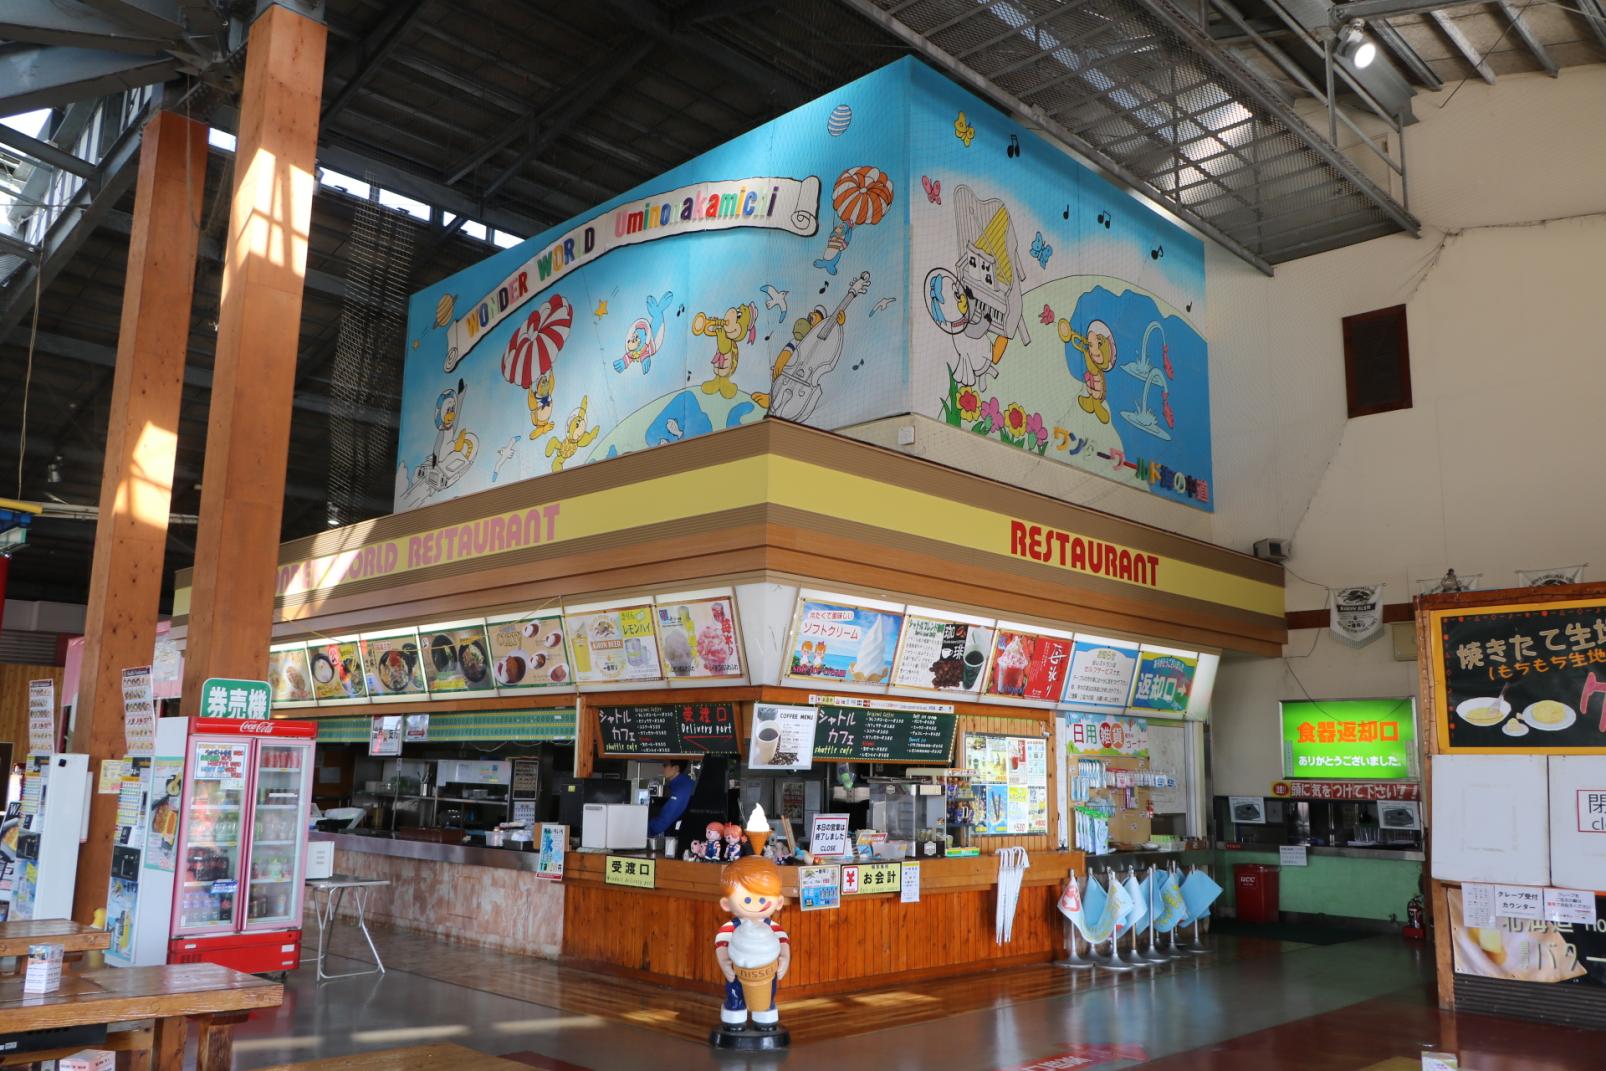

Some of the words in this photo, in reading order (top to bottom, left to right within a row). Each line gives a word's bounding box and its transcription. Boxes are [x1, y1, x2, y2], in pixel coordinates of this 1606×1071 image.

[465, 271, 529, 339] WONDER
[536, 227, 596, 282] WORLD
[408, 504, 560, 569] RESTAURANT
[1010, 519, 1160, 587] RESTAURANT
[622, 623, 651, 635] レモンハイ
[803, 622, 859, 640] ソフトクリーム
[1136, 672, 1178, 702] 返却口
[207, 686, 268, 720] 券売機
[600, 708, 632, 724] シャトル
[682, 706, 728, 724] 受渡口
[818, 708, 856, 726] シャトル
[612, 727, 636, 742] カフェ
[681, 723, 713, 734] Delivery
[1297, 721, 1399, 744] 食器返却口
[828, 729, 855, 746] カフェ
[816, 823, 845, 832] 本日の営業は
[815, 832, 844, 841] 終了しました
[611, 860, 649, 876] 受渡口
[863, 870, 897, 885] お会計
[1498, 891, 1539, 901] クレープ受付
[1502, 901, 1537, 910] カウンター
[739, 967, 775, 981] nissei
